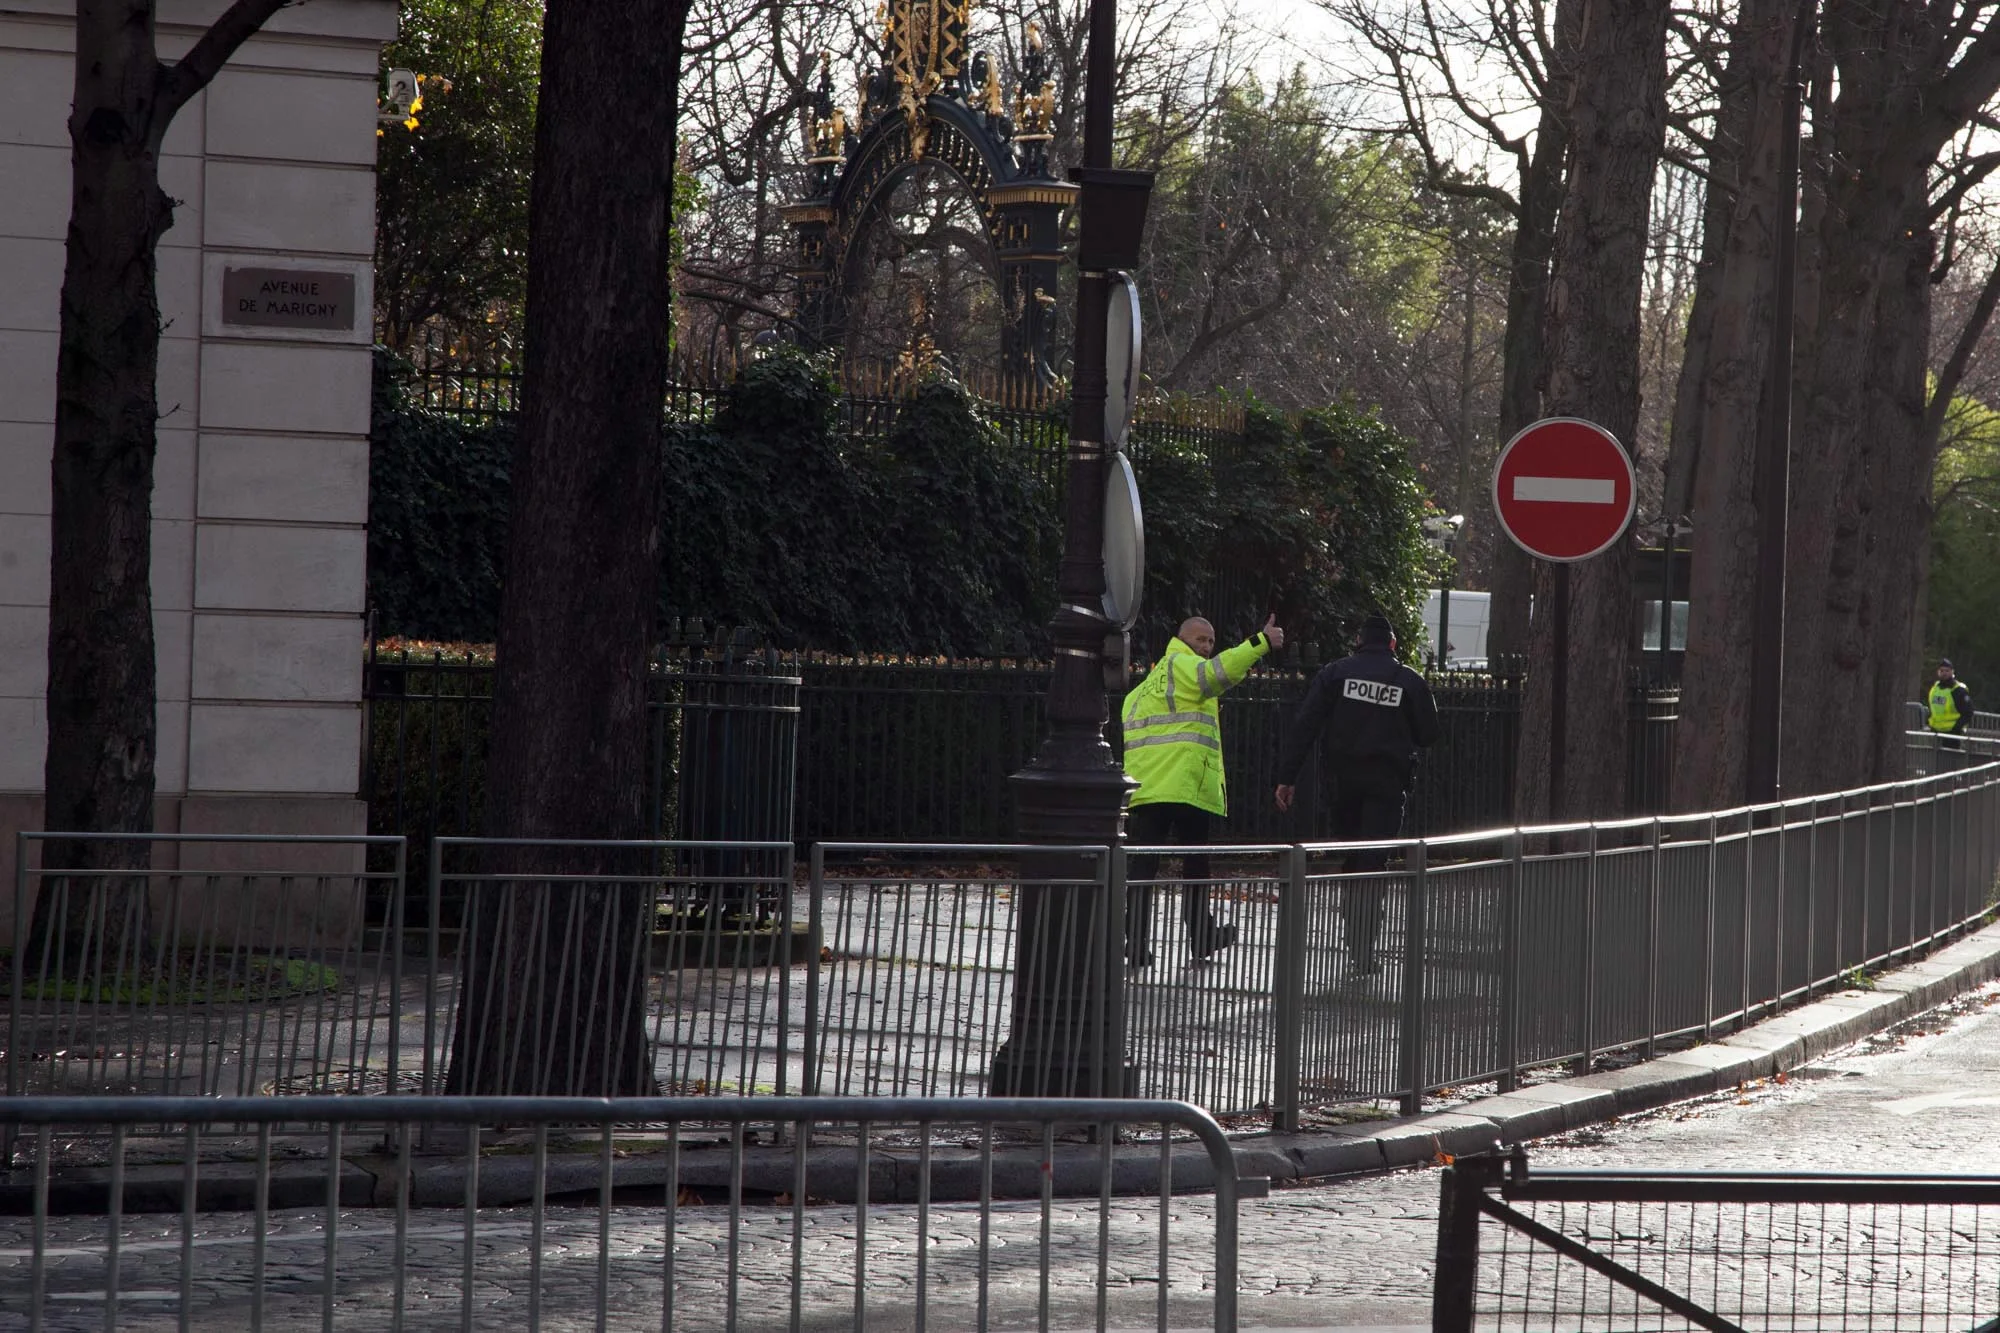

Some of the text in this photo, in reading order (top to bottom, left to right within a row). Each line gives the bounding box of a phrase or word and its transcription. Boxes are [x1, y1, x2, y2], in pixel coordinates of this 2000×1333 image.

[260, 281, 320, 296] AVENUE
[239, 298, 338, 317] DE MARIGNY
[1347, 681, 1399, 703] POLICE
